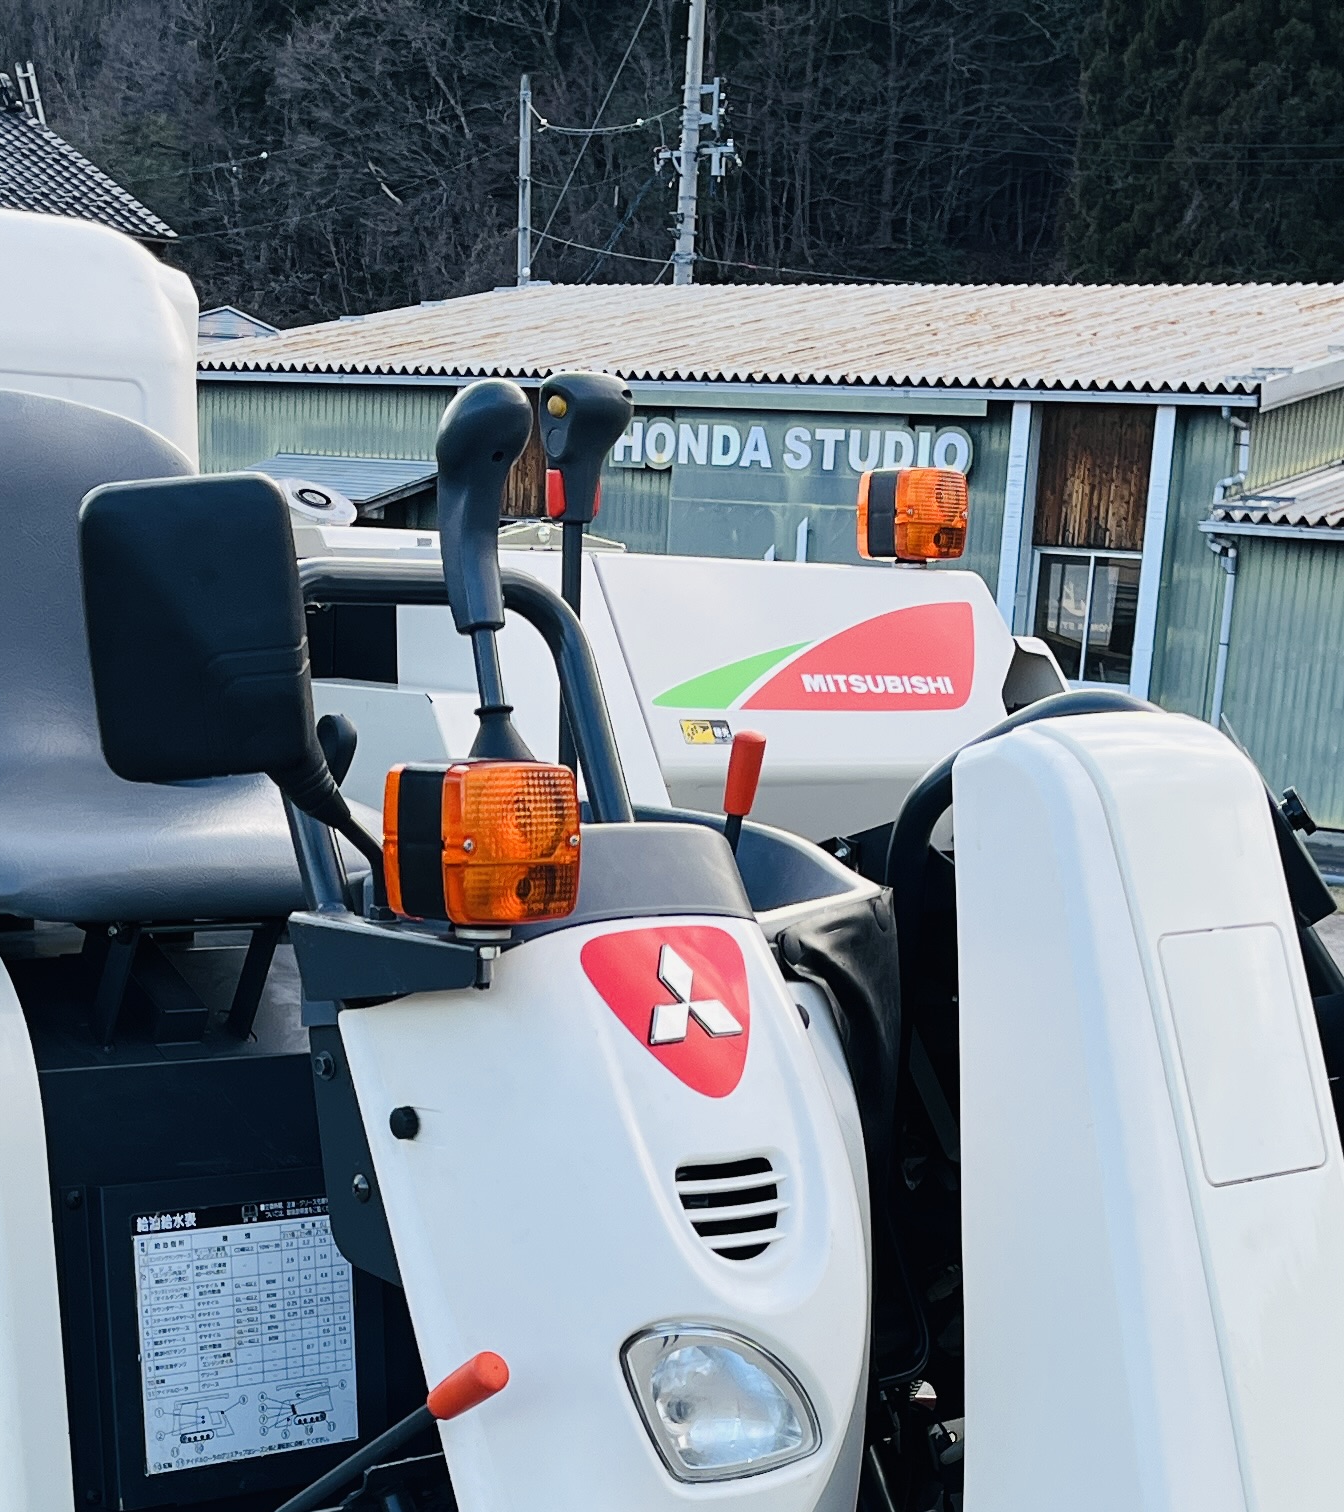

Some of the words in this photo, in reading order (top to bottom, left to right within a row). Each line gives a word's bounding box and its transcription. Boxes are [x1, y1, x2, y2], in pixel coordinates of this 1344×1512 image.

[613, 420, 772, 469] HONDA
[782, 425, 970, 473] STUDIO
[800, 673, 955, 696] MITSUBISHI
